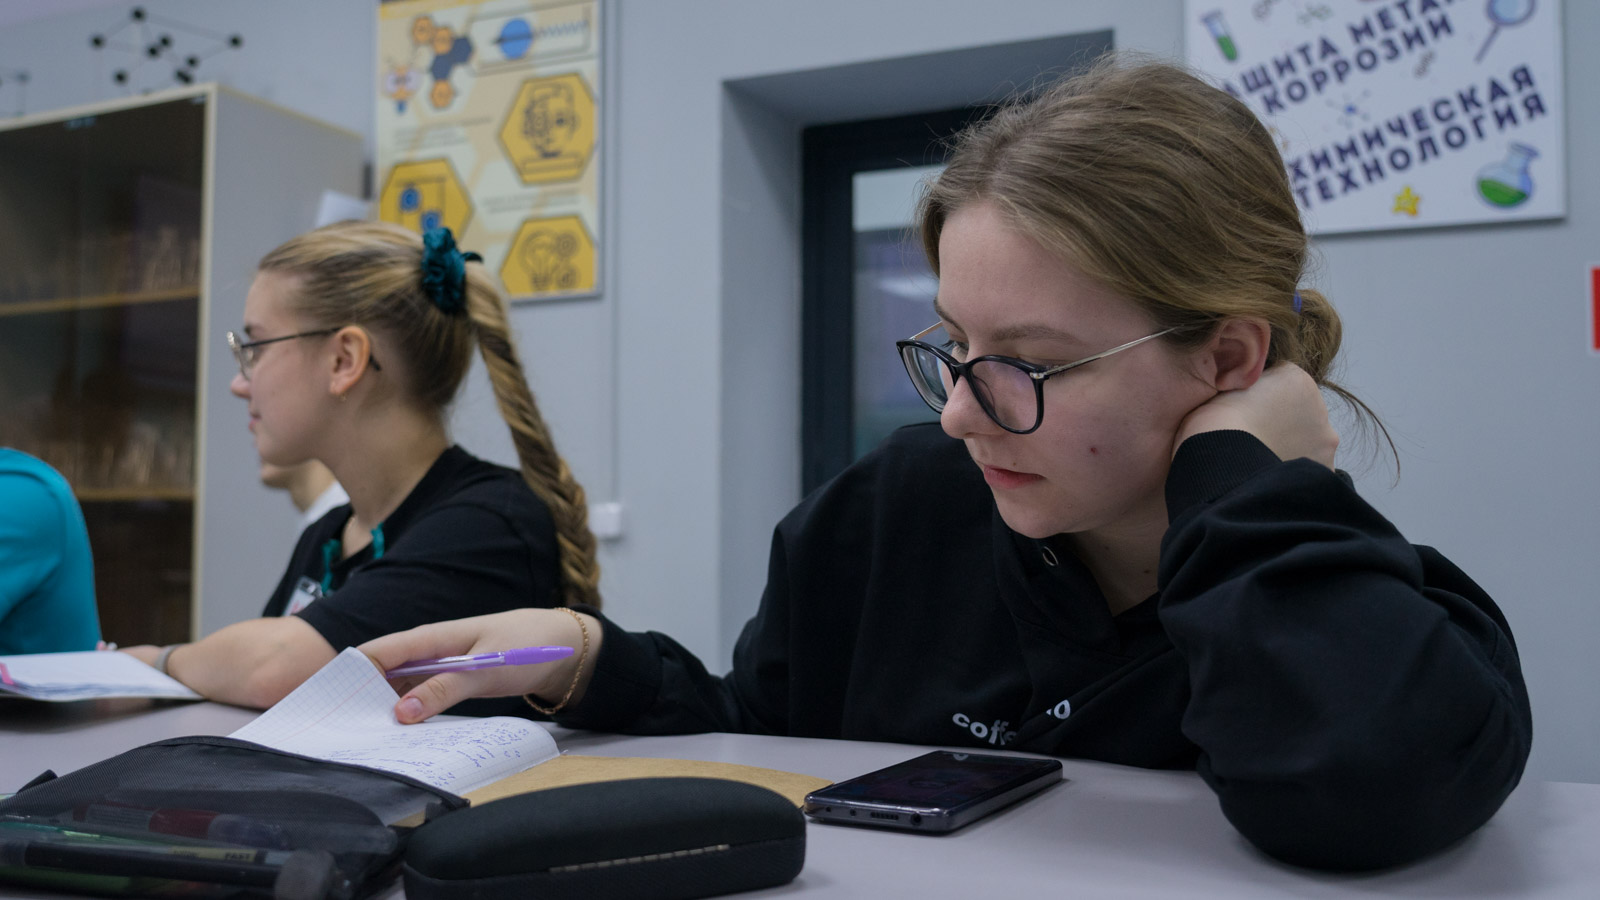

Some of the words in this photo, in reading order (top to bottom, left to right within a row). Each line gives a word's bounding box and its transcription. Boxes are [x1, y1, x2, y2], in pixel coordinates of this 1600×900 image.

[1222, 35, 1339, 98] АЩИТА
[1348, 0, 1452, 43] МЕТА
[1262, 14, 1453, 115] КОРРОЗИИ
[1287, 64, 1535, 183] ХИМИЧЕСКАЯ
[1295, 92, 1547, 209] ТЕХНОЛОГИЯ
